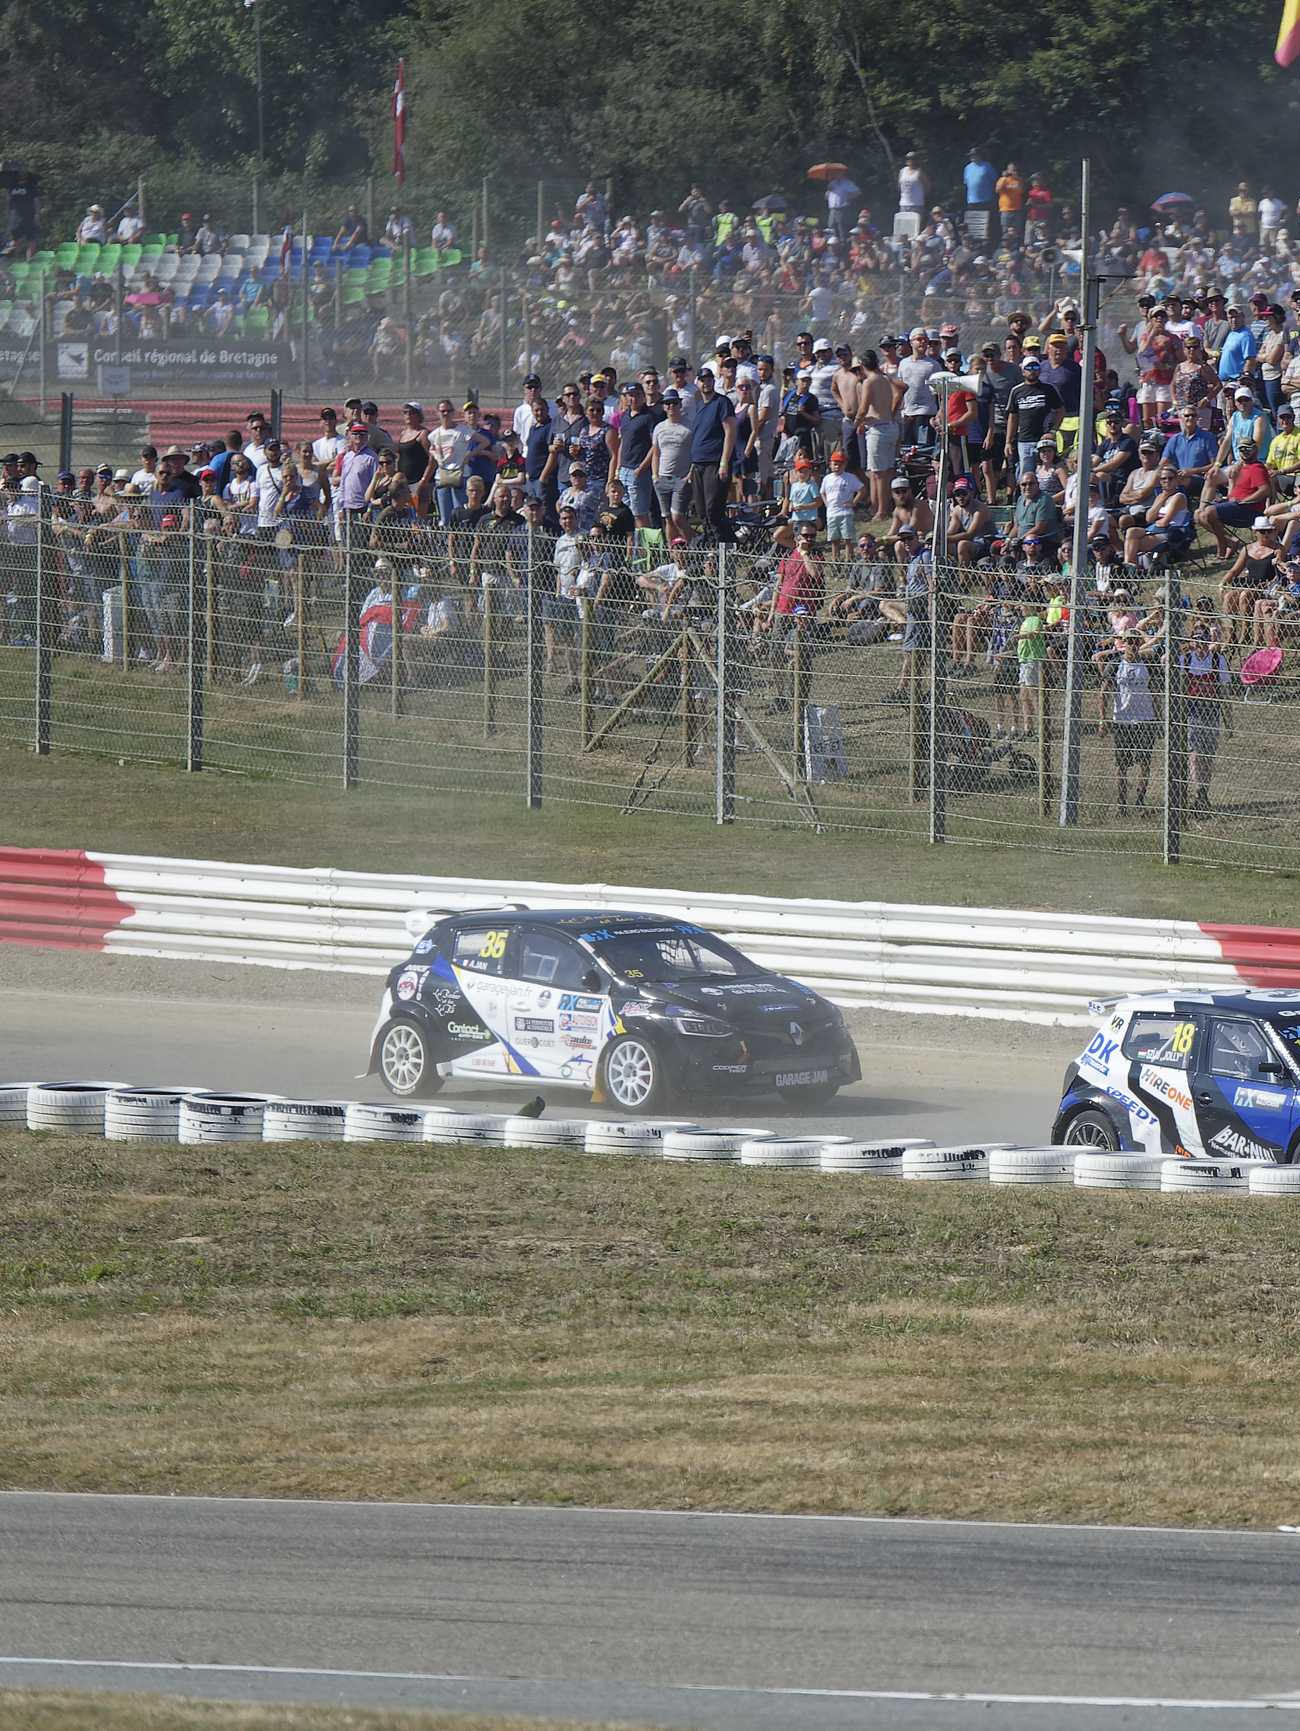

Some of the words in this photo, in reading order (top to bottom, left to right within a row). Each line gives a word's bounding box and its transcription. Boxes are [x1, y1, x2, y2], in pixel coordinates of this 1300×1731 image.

[144, 349, 196, 367] régional
[200, 350, 215, 364] de
[219, 350, 278, 367] Bretagne
[480, 931, 508, 958] 35
[624, 969, 645, 978] 35
[1088, 1032, 1119, 1064] DK
[1172, 1022, 1195, 1053] 18
[1141, 1068, 1193, 1109] HIREONE
[1104, 1085, 1158, 1125] SPEEDY
